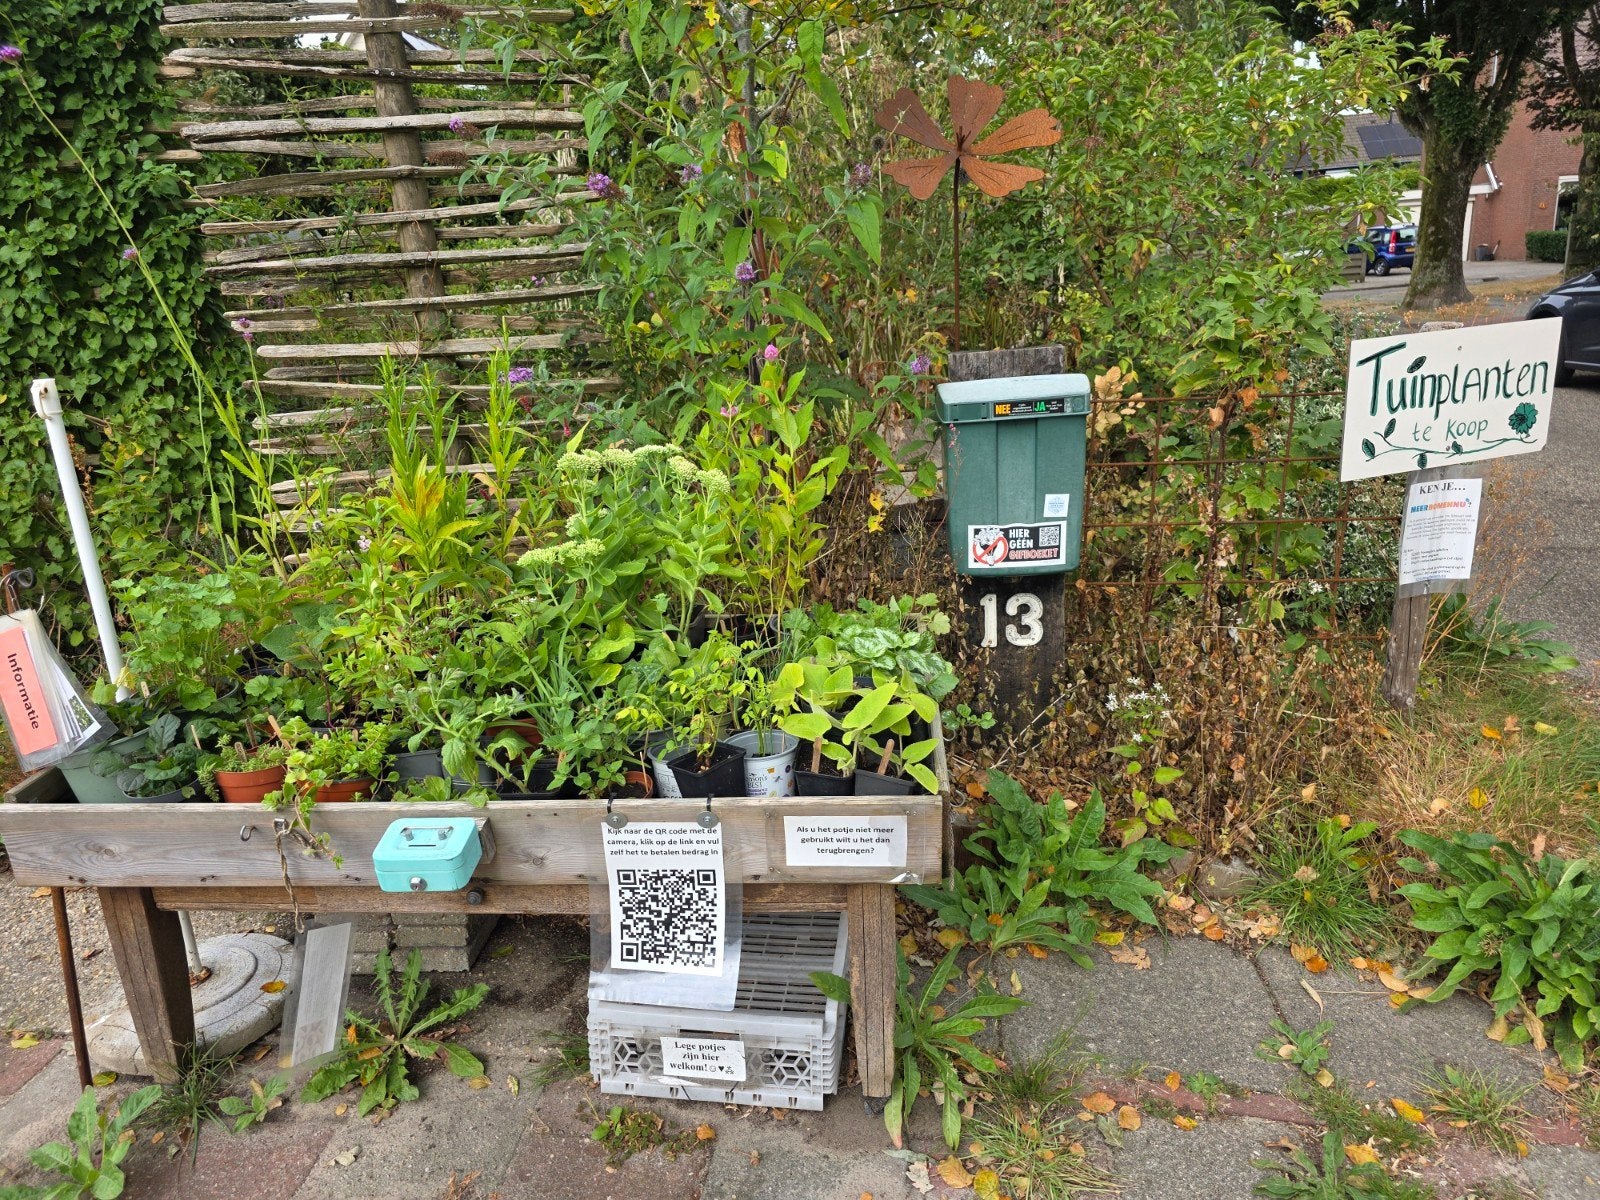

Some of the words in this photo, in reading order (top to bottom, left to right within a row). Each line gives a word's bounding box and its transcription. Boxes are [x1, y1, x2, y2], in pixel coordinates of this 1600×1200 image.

[1356, 342, 1549, 420] Tuinplanten
[995, 403, 1011, 414] NEE
[1034, 401, 1046, 412] JA
[1412, 422, 1432, 442] te
[1419, 483, 1440, 494] KEN
[1008, 528, 1030, 538] HIER
[1008, 538, 1034, 549] GÉÉN
[980, 592, 1044, 648] 13
[7, 653, 39, 730] Informatie
[833, 826, 854, 834] potje
[682, 848, 709, 857] bedrag
[817, 847, 875, 855] terugbrengen?
[675, 1042, 696, 1050] Lege
[698, 1044, 726, 1052] potjes
[682, 1052, 699, 1061] zijn
[670, 1062, 708, 1072] welkom!
